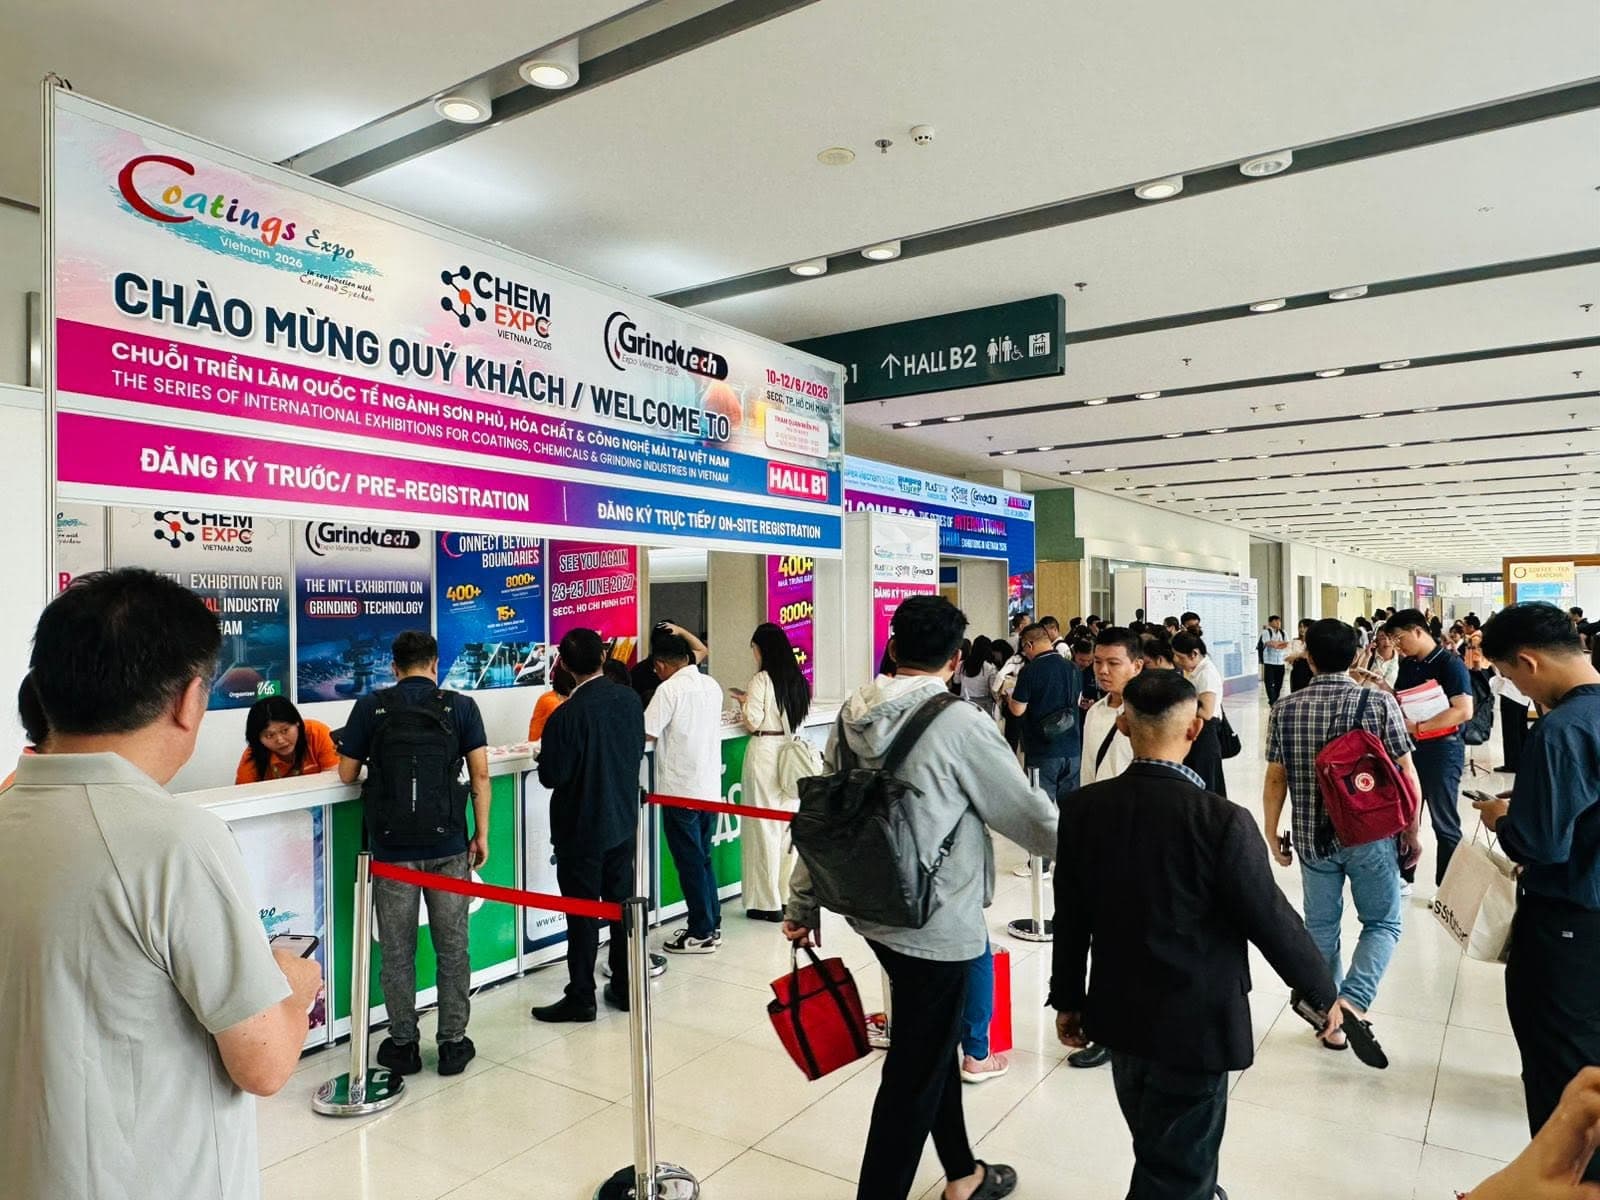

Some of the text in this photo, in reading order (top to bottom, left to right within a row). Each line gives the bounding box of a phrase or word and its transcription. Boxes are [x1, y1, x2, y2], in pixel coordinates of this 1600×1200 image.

[118, 155, 296, 246] Coatings
[220, 236, 304, 268] Vietnam 2026
[305, 229, 354, 260] Expo
[316, 274, 355, 288] conjunction
[357, 284, 372, 292] with
[474, 271, 550, 317] CHEM
[497, 330, 552, 350] VIETNAM 2026
[114, 272, 730, 441] CHÀO MỪNG QUÝ KHÁCH / WELCOME TO
[904, 344, 976, 377] HALL B2
[766, 369, 828, 400] 10-12/6/2026
[112, 342, 188, 371] CHUỖI
[194, 356, 252, 384] TRIỂN
[258, 366, 298, 392] LÃM
[302, 376, 356, 402] QUỐC
[360, 384, 378, 406] TẾ
[382, 391, 440, 416] NGÀNH
[443, 405, 474, 422] SƠN
[510, 414, 538, 435] HÓA
[541, 420, 575, 442] CHẤT
[576, 430, 586, 442] &
[588, 430, 620, 448] CÔNG
[622, 439, 650, 458] NGHỆ
[652, 441, 670, 458] MÀI
[672, 446, 688, 461] TẠI
[688, 450, 708, 466] VIỆT
[708, 455, 730, 468] NAM
[112, 370, 729, 483] THE SERIES OF INTERNATIONAL EXHIBITIONS FOR COATINGS, CHEMICALS & GRINDING INDUSTRIES IN VIETNAM
[140, 445, 218, 478] ĐĂNG
[224, 456, 258, 482] KÝ
[356, 476, 530, 512] PRE-REGISTRATION
[769, 466, 808, 493] HALL
[811, 474, 827, 496] B1
[182, 512, 252, 528] CHEM
[598, 500, 634, 522] ĐĂNG
[636, 504, 652, 524] KÝ
[656, 508, 686, 532] TRỰC
[718, 516, 758, 534] ON-SITE
[759, 521, 820, 539] REGISTRATION
[202, 544, 234, 552] VIETNAM
[502, 535, 540, 550] BEYOND
[482, 550, 540, 568] BOUNDARIES
[560, 549, 628, 572] SEE YOU AGAIN
[778, 554, 814, 577] 400+
[190, 574, 258, 590] EXHIBITION
[261, 575, 282, 590] FOR
[305, 579, 423, 594] THE INT'L EXHIBITION ON
[506, 573, 536, 588] 8000+
[552, 580, 584, 602] 23-25
[585, 576, 610, 597] JUNE
[610, 574, 634, 593] 2027
[446, 584, 482, 602] 400+
[223, 598, 280, 612] INDUSTRY
[310, 600, 424, 614] GRINDING TECHNOLOGY
[496, 606, 516, 621] 15+
[552, 596, 635, 616] SECC, HO CHI MINH CITY
[780, 601, 814, 625] 8000+
